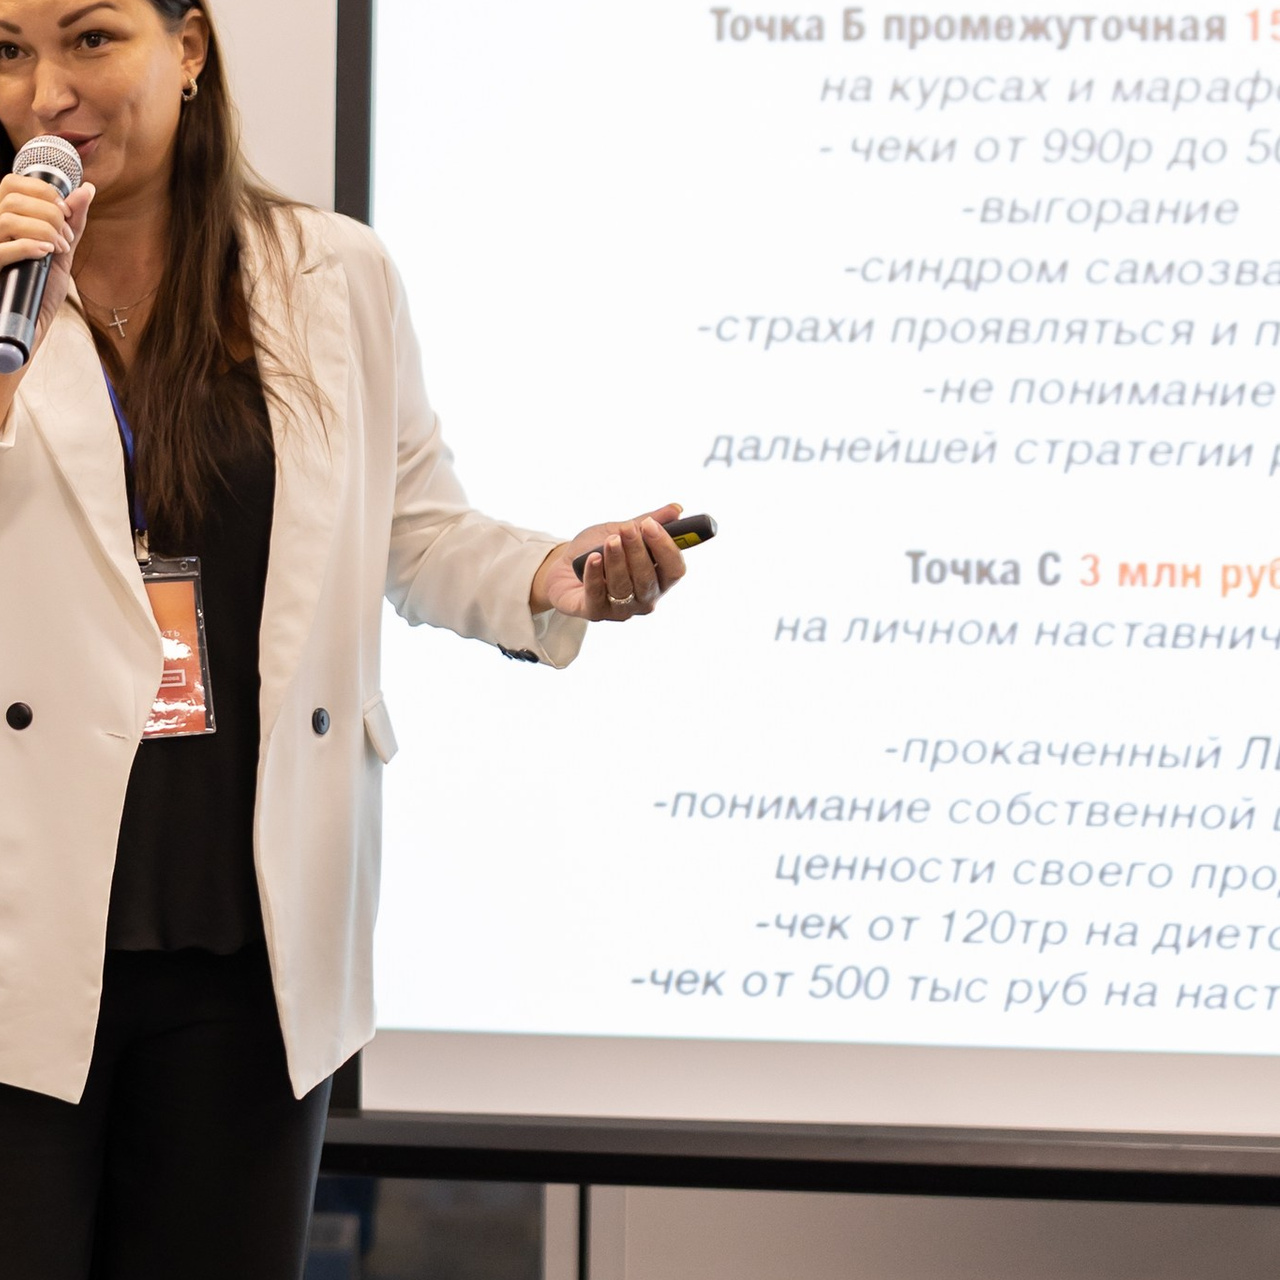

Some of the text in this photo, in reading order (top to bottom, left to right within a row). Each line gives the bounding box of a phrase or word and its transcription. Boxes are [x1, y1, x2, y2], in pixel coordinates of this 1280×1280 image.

[709, 6, 825, 42] Точка
[842, 6, 866, 42] Б
[883, 14, 1227, 51] промежуточная
[819, 69, 1280, 113] на курсах и мараф
[850, 135, 958, 163] чеки
[973, 136, 1027, 164] от
[1043, 127, 1154, 173] 990р
[1165, 137, 1228, 172] до
[1245, 128, 1280, 165] 5
[962, 196, 1240, 233] -выгорание
[844, 257, 1280, 293] -синдром самозва
[698, 315, 875, 351] -страхи
[890, 316, 1195, 352] проявляться
[1210, 321, 1238, 346] и
[923, 378, 1276, 408] -не понимание
[702, 430, 998, 469] дальнейшей
[1014, 439, 1255, 474] стратегии
[904, 549, 1021, 586] Точка
[1037, 550, 1062, 587] С
[1080, 553, 1101, 587] 3
[1118, 562, 1202, 588] млн
[774, 616, 1280, 650] на личном наставнич
[884, 735, 1280, 773] -прокаченный Л
[653, 791, 931, 824] -понимание
[948, 791, 1256, 831] собственной
[775, 854, 1280, 899] ценности своего про
[755, 913, 851, 940] -чек
[867, 915, 920, 942] от
[942, 909, 1068, 954] 120тр
[1085, 921, 1139, 947] на
[630, 963, 1280, 1014] -чек от 500 тыс руб на наст
